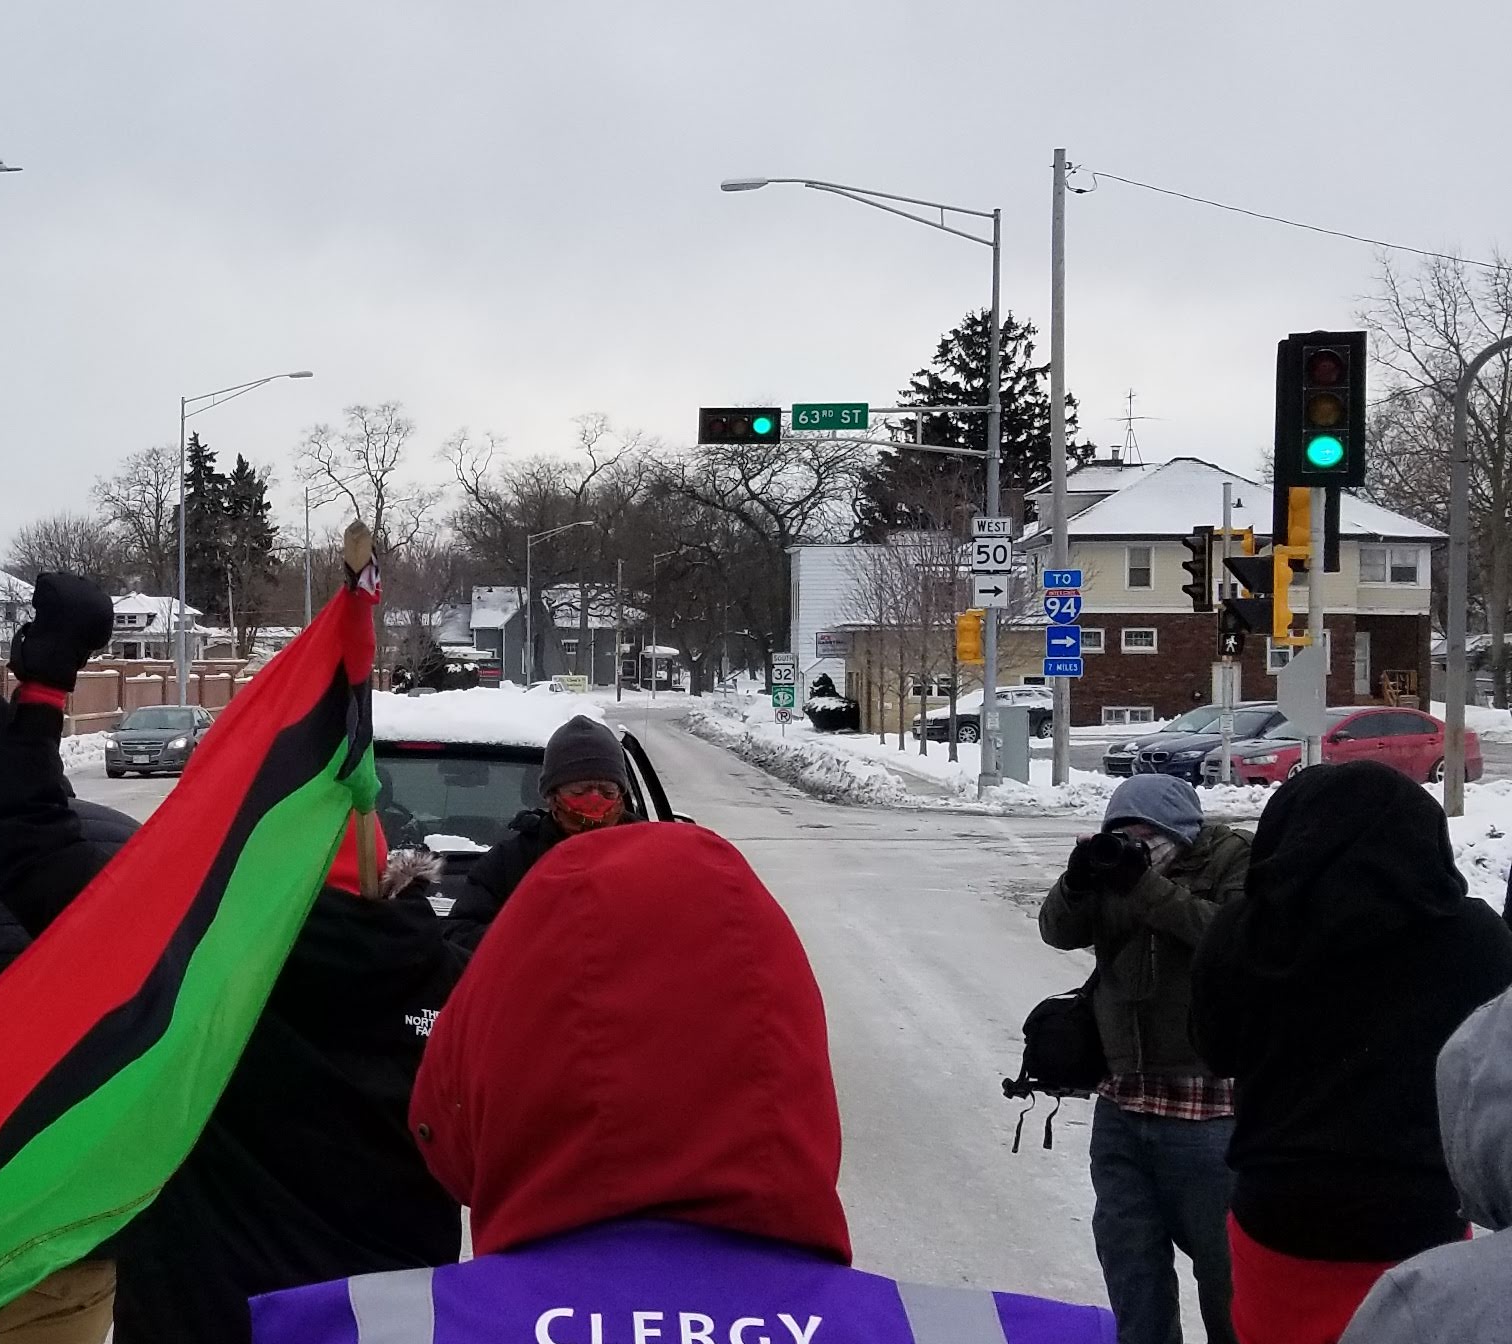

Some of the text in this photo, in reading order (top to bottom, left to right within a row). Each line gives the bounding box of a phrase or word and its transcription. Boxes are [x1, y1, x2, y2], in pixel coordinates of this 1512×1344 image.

[798, 409, 862, 424] 63RD ST
[977, 521, 1007, 532] WEST
[976, 544, 1008, 564] 50
[1052, 573, 1072, 585] TO
[1046, 597, 1077, 618] 94
[1048, 663, 1079, 672] 7 MILES
[774, 668, 792, 681] 32
[404, 1014, 436, 1028] NORT
[415, 1025, 433, 1037] FA
